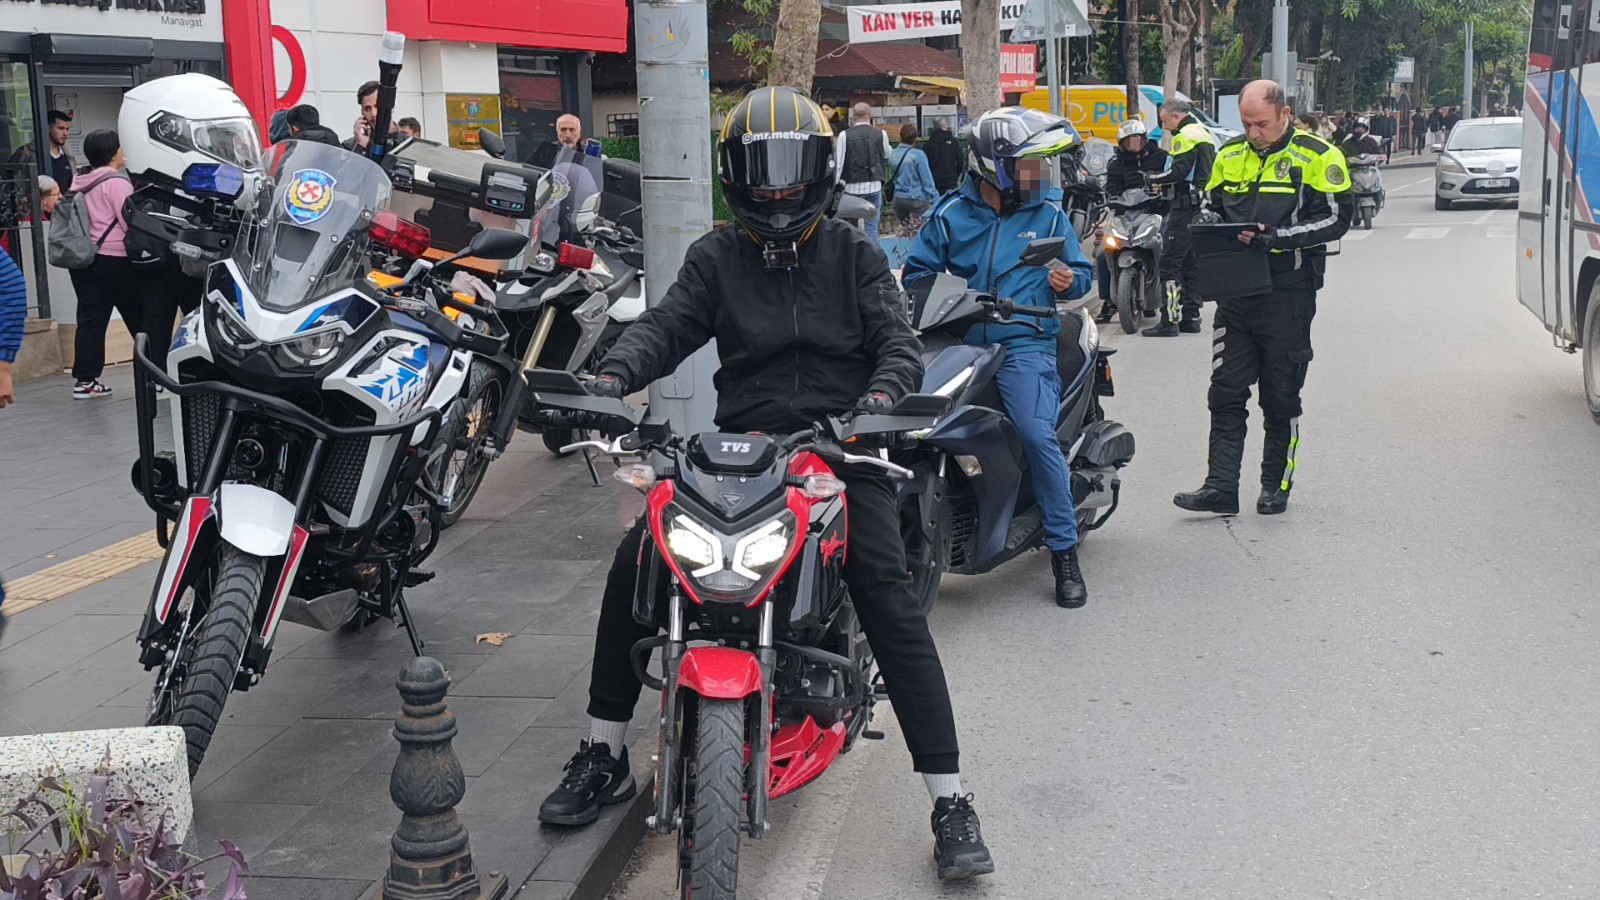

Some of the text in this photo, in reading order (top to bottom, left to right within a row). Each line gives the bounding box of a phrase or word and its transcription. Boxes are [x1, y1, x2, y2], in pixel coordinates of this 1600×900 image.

[161, 16, 203, 28] Manavgat
[862, 13, 897, 33] KAN
[901, 11, 935, 29] VER
[941, 9, 962, 25] HA
[1094, 102, 1127, 125] Ptt
[742, 131, 810, 145] @mr.metow
[721, 441, 751, 453] TVS
